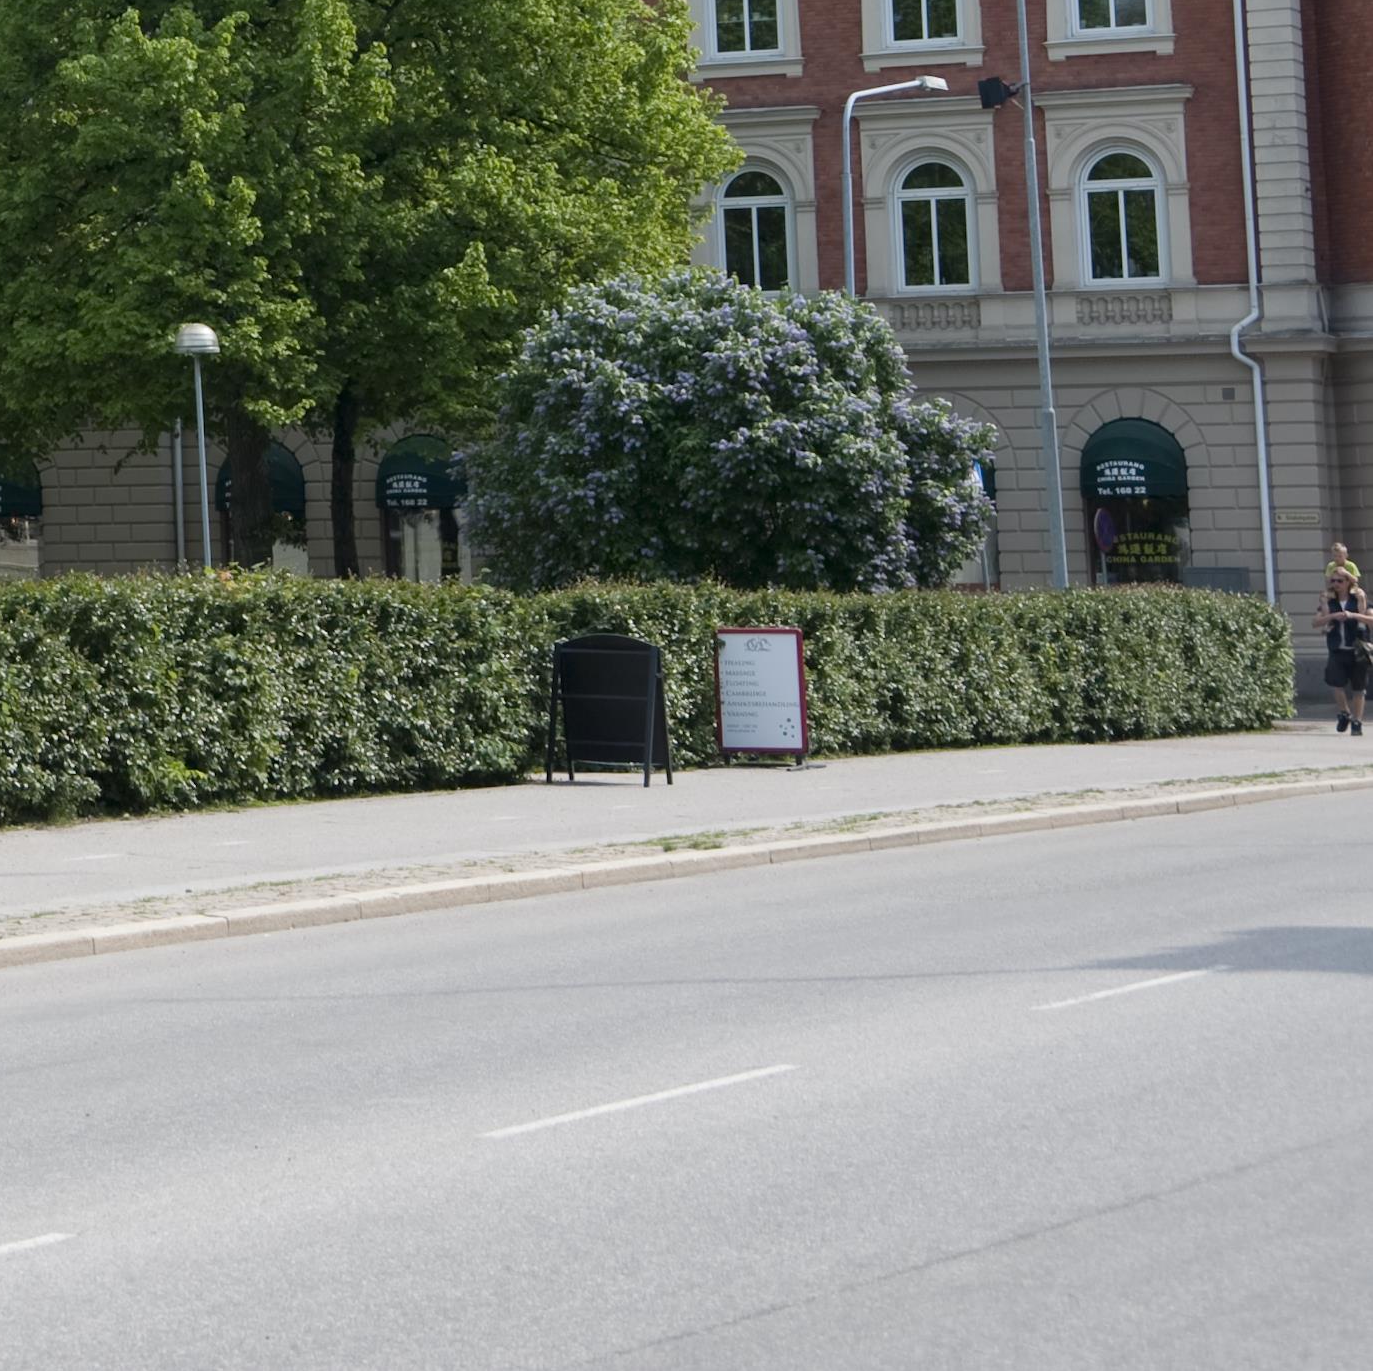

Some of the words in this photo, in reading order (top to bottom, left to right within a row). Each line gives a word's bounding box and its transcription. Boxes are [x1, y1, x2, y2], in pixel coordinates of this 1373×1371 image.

[1096, 460, 1145, 471] RESTAURANG
[1097, 487, 1114, 495] Tel.
[1134, 486, 1147, 494] 22
[1112, 532, 1180, 545] ESTAURANG
